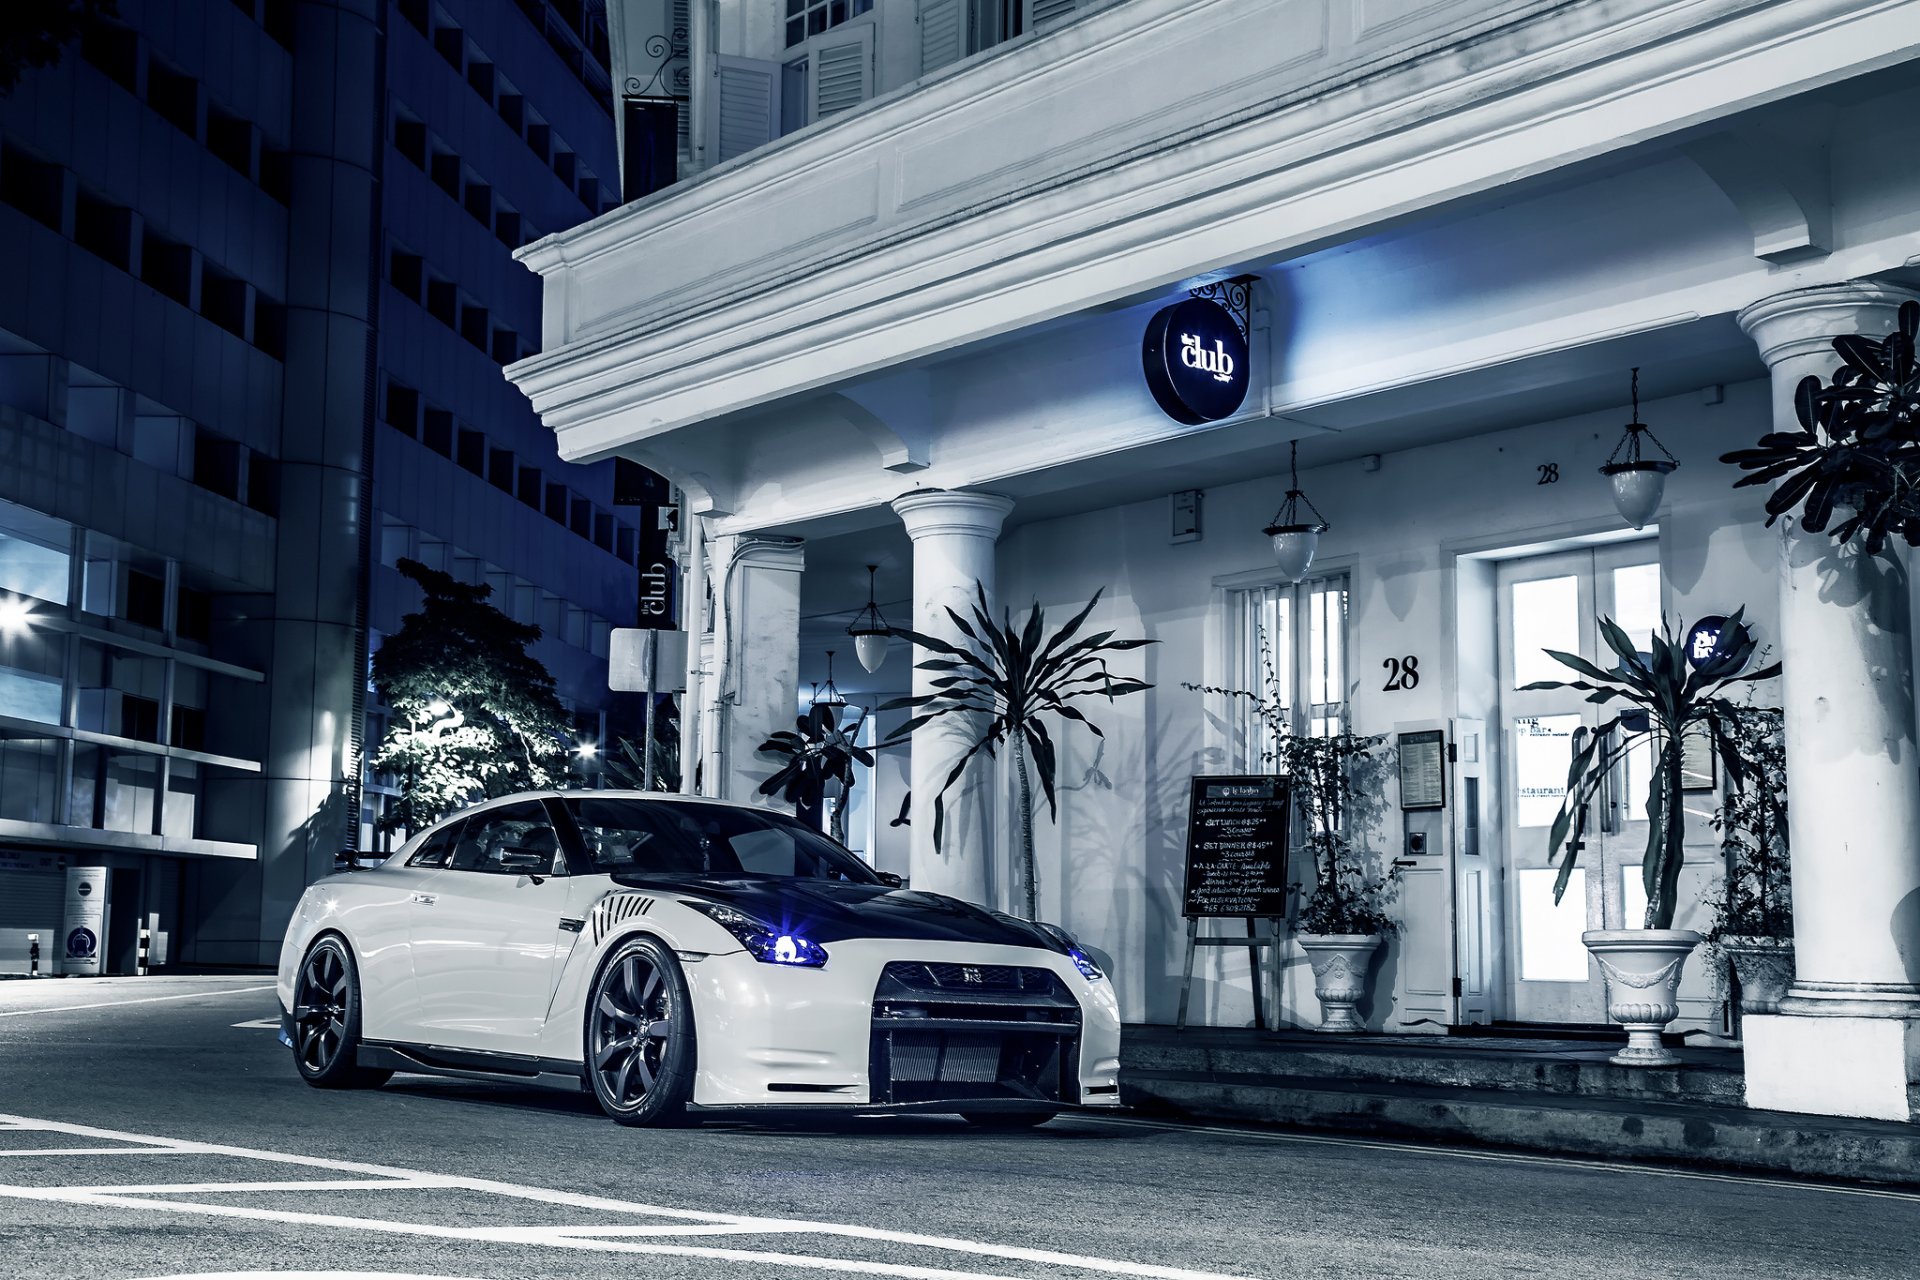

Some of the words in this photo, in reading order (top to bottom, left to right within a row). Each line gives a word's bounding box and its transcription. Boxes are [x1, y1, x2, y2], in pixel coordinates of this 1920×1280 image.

[1181, 334, 1234, 375] club
[1537, 462, 1560, 486] 28
[641, 563, 666, 615] club
[1382, 655, 1420, 692] 28
